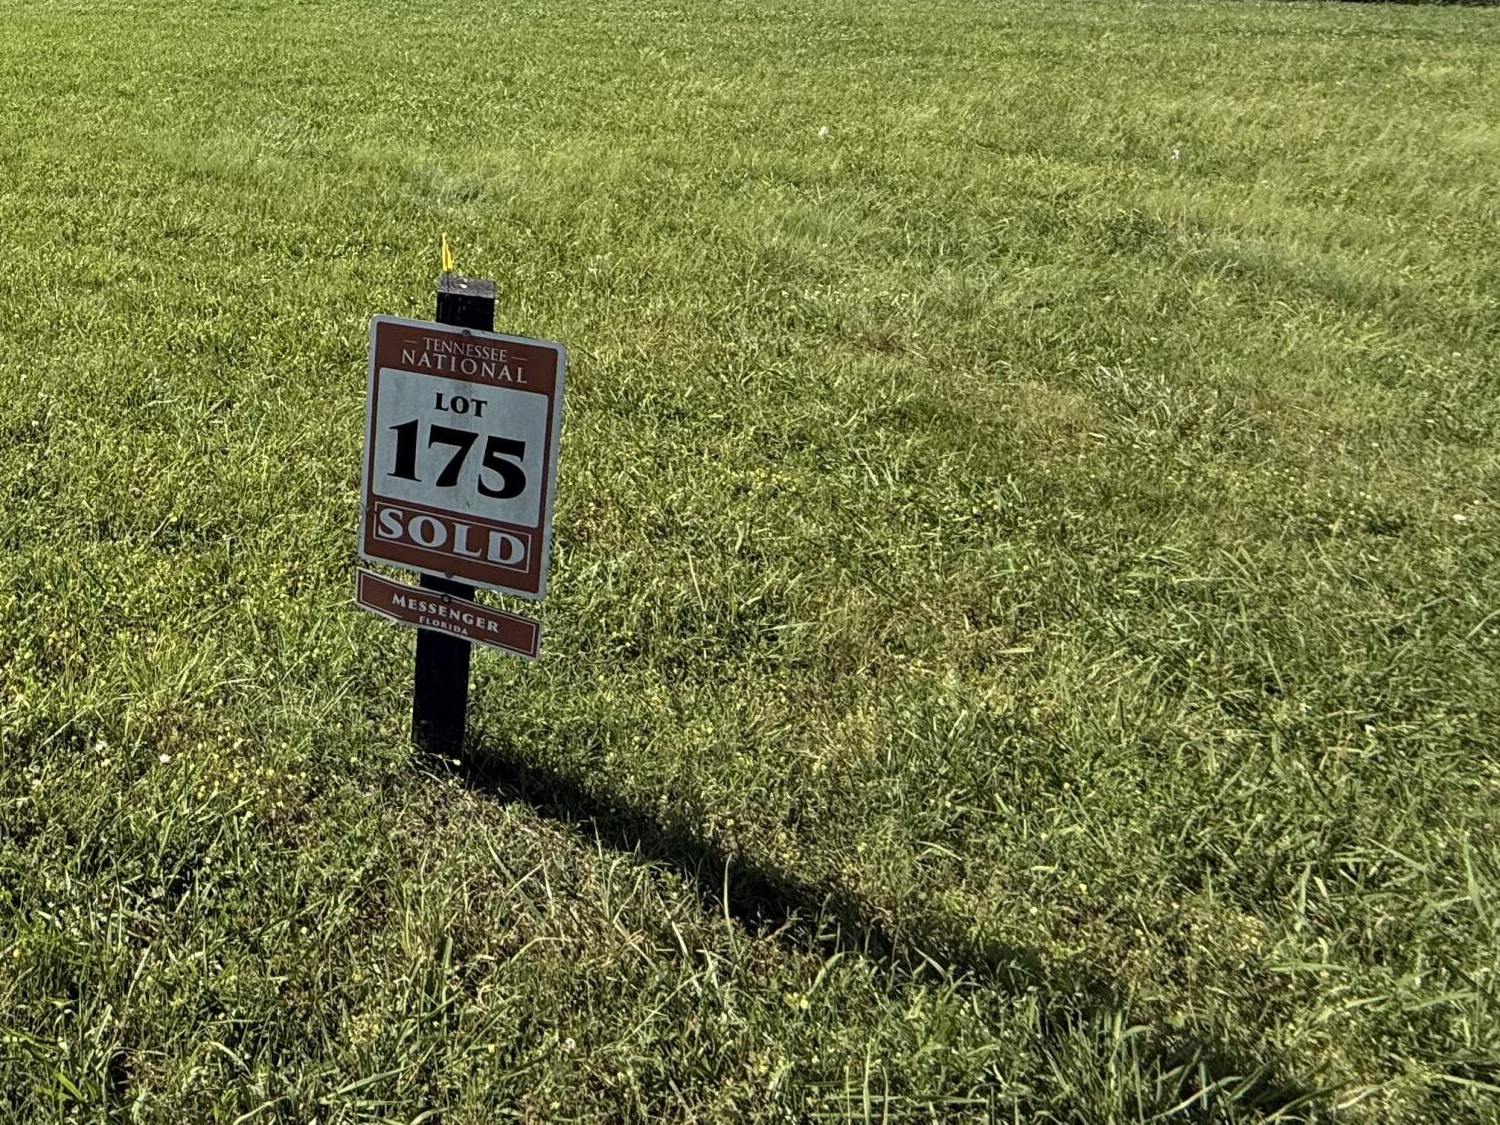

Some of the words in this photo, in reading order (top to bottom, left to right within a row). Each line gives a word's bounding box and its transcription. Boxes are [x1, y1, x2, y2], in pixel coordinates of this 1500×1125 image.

[401, 349, 528, 384] NATIONAL
[423, 337, 508, 363] TENNESSEE
[435, 392, 488, 418] LOT
[387, 419, 527, 499] 175
[377, 507, 526, 566] SOLD
[391, 592, 500, 634] MESSENGER
[418, 615, 469, 636] FLORIDA
